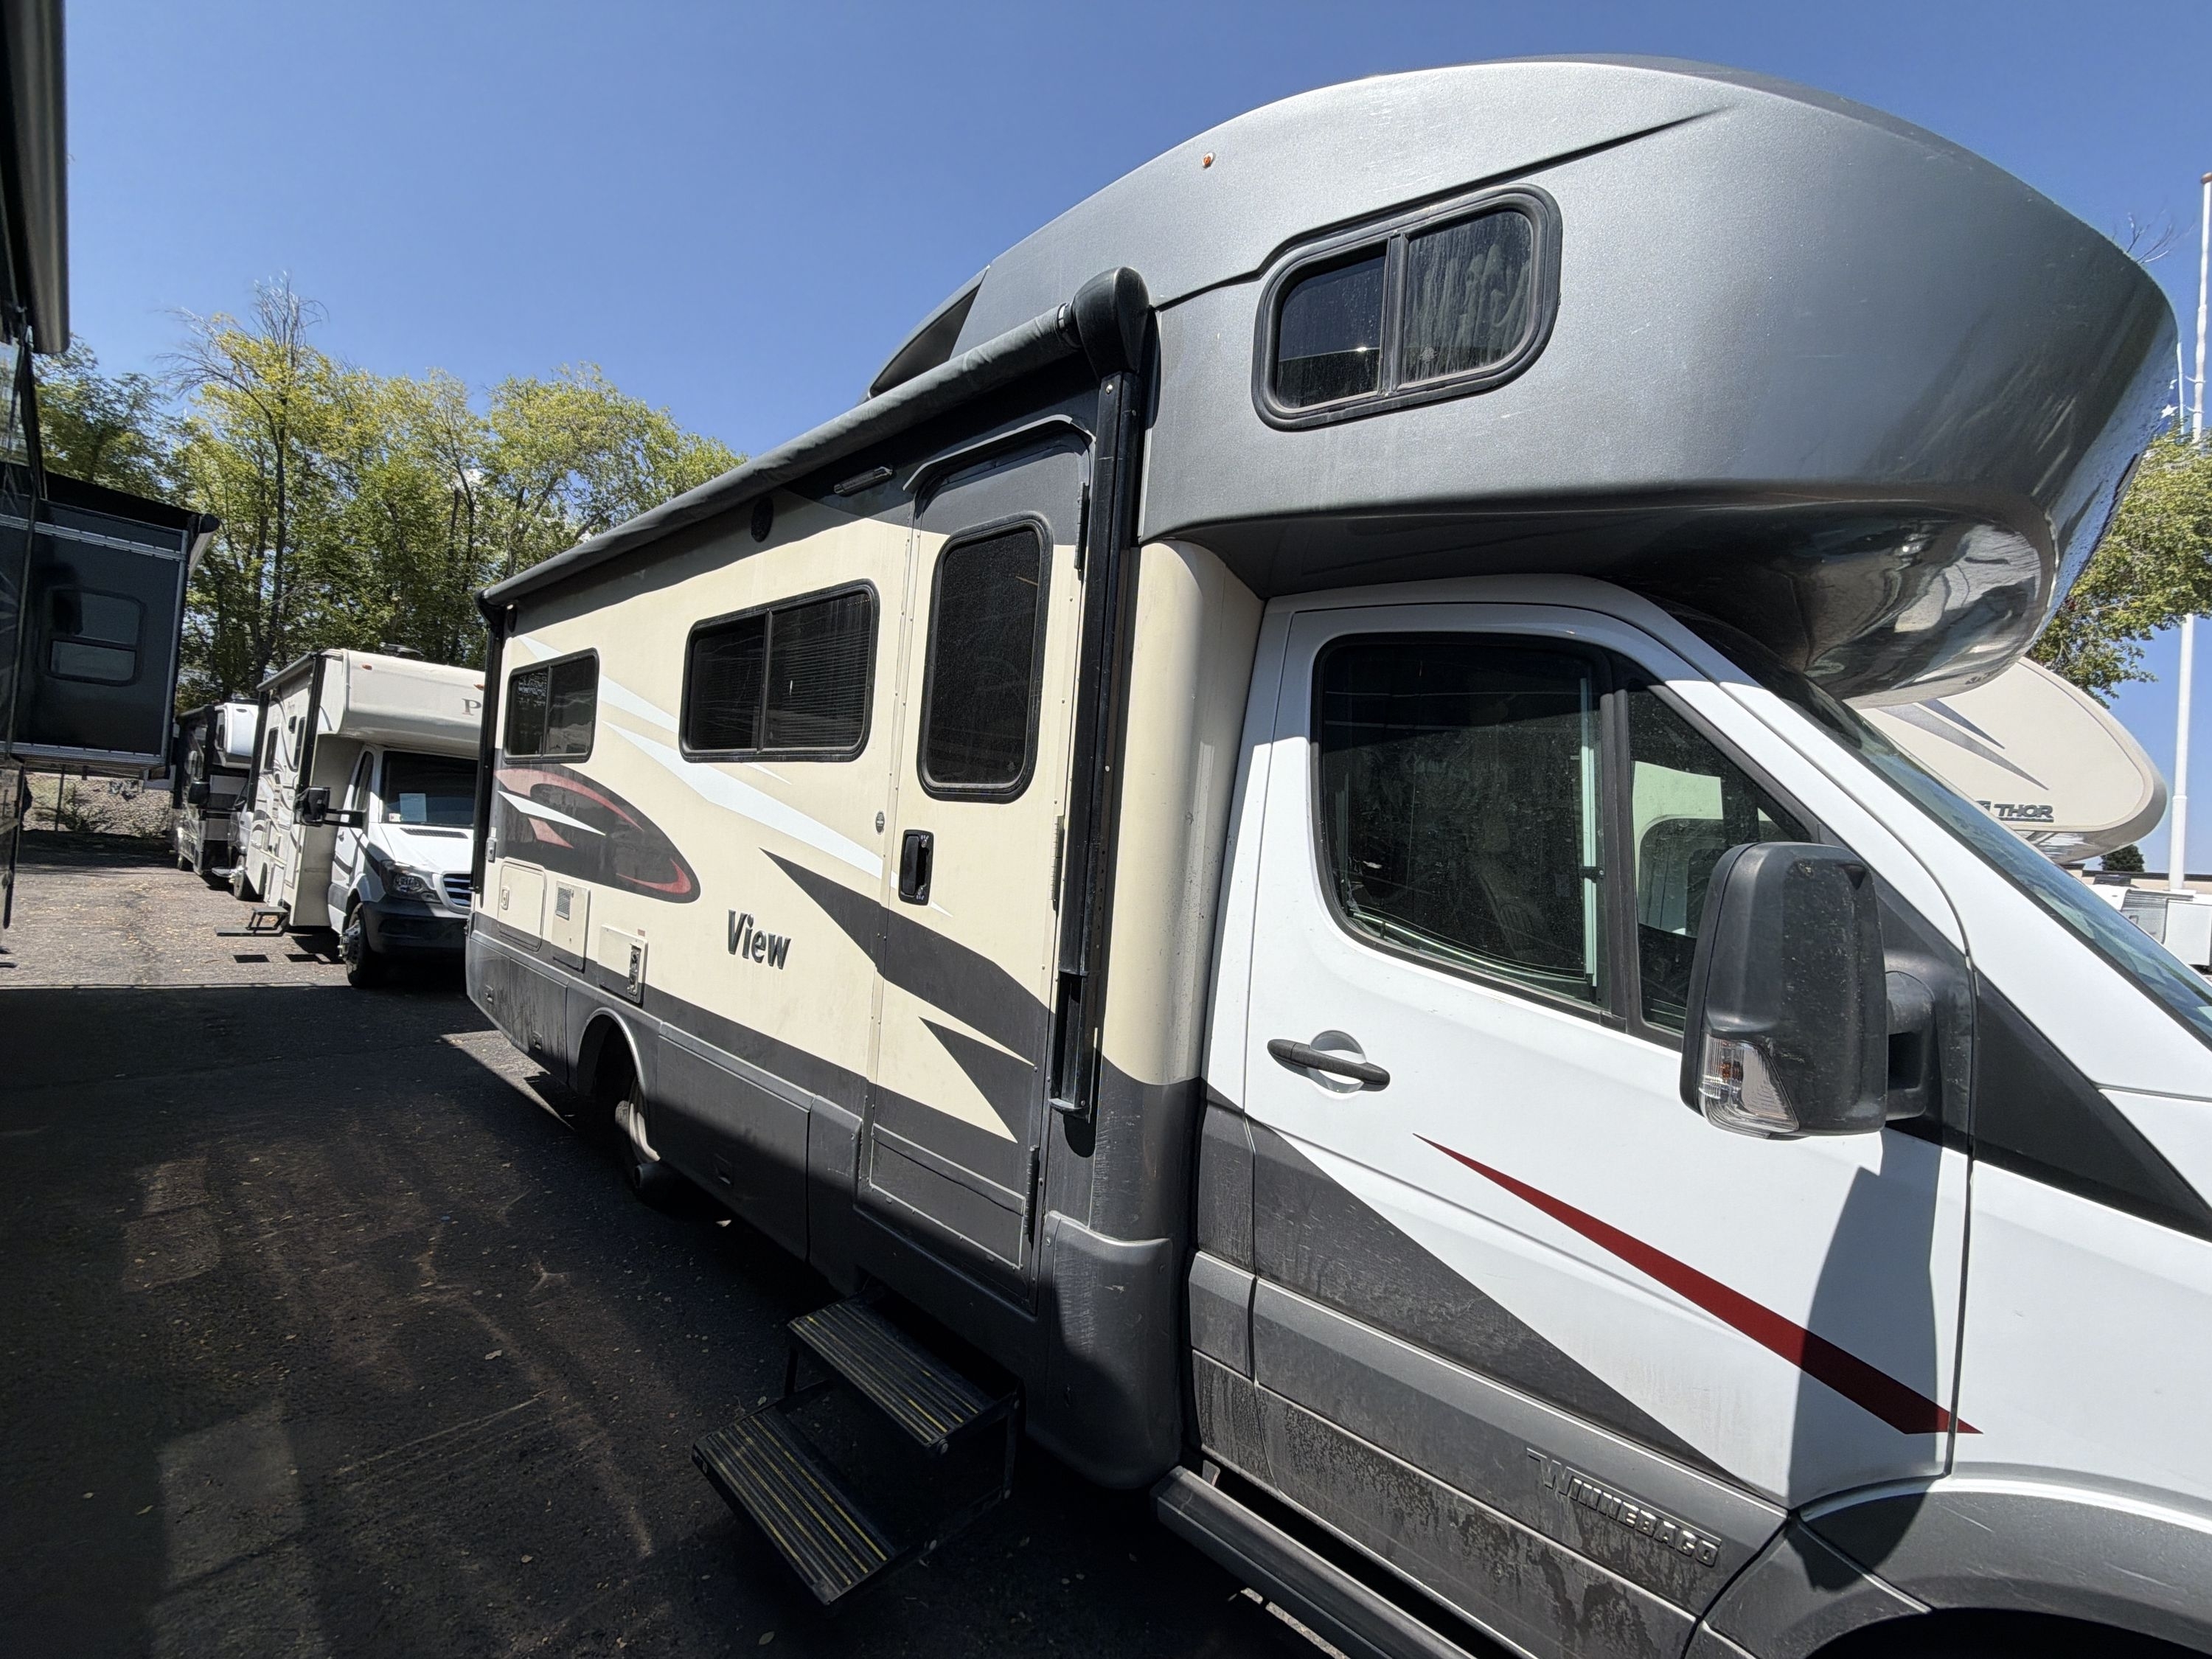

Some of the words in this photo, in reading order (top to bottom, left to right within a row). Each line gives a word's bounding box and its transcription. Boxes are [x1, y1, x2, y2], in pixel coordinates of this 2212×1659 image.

[1994, 804, 2054, 818] THOR
[728, 908, 791, 970] View
[1526, 1447, 1722, 1568] WINNEBAGO
